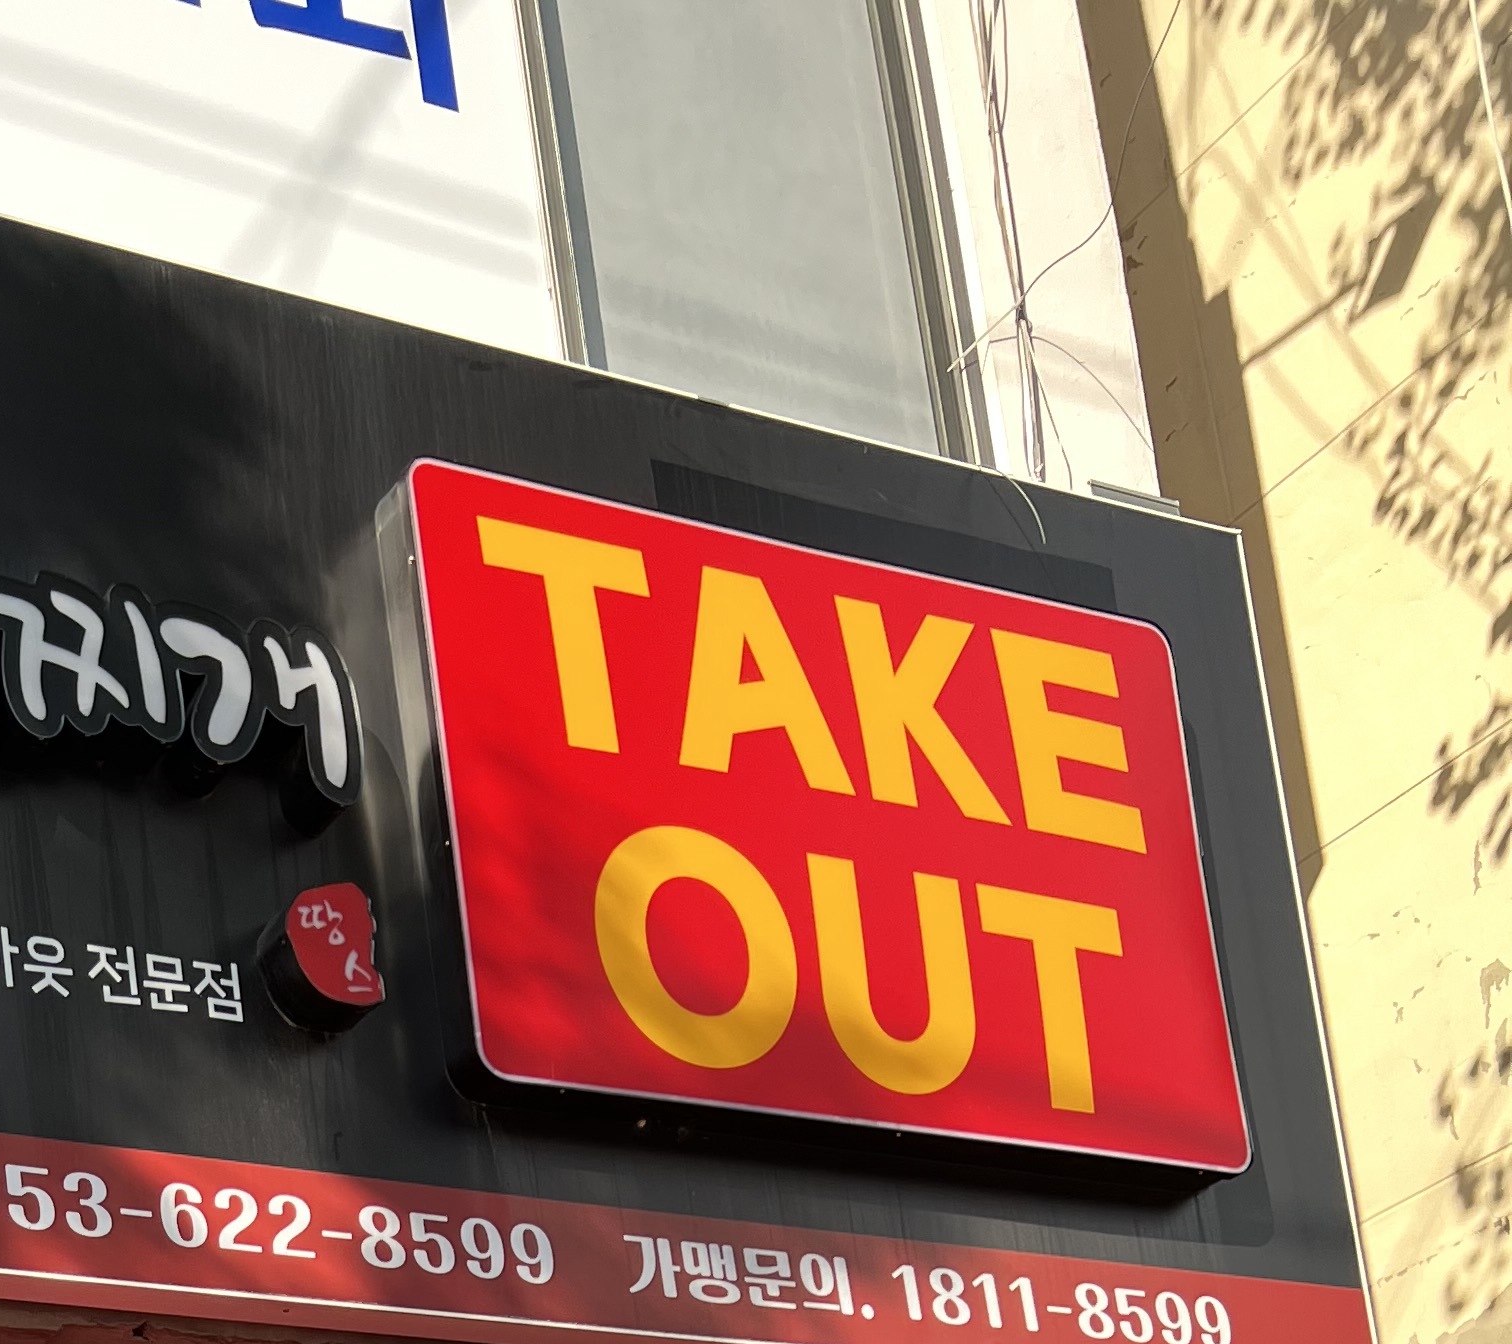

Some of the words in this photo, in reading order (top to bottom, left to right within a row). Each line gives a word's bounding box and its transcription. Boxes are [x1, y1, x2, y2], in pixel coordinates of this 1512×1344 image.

[476, 514, 1149, 854] TAKE
[86, 941, 245, 1023] 전문점
[593, 825, 1125, 1115] OUT
[622, 1230, 875, 1321] 가맹문의.
